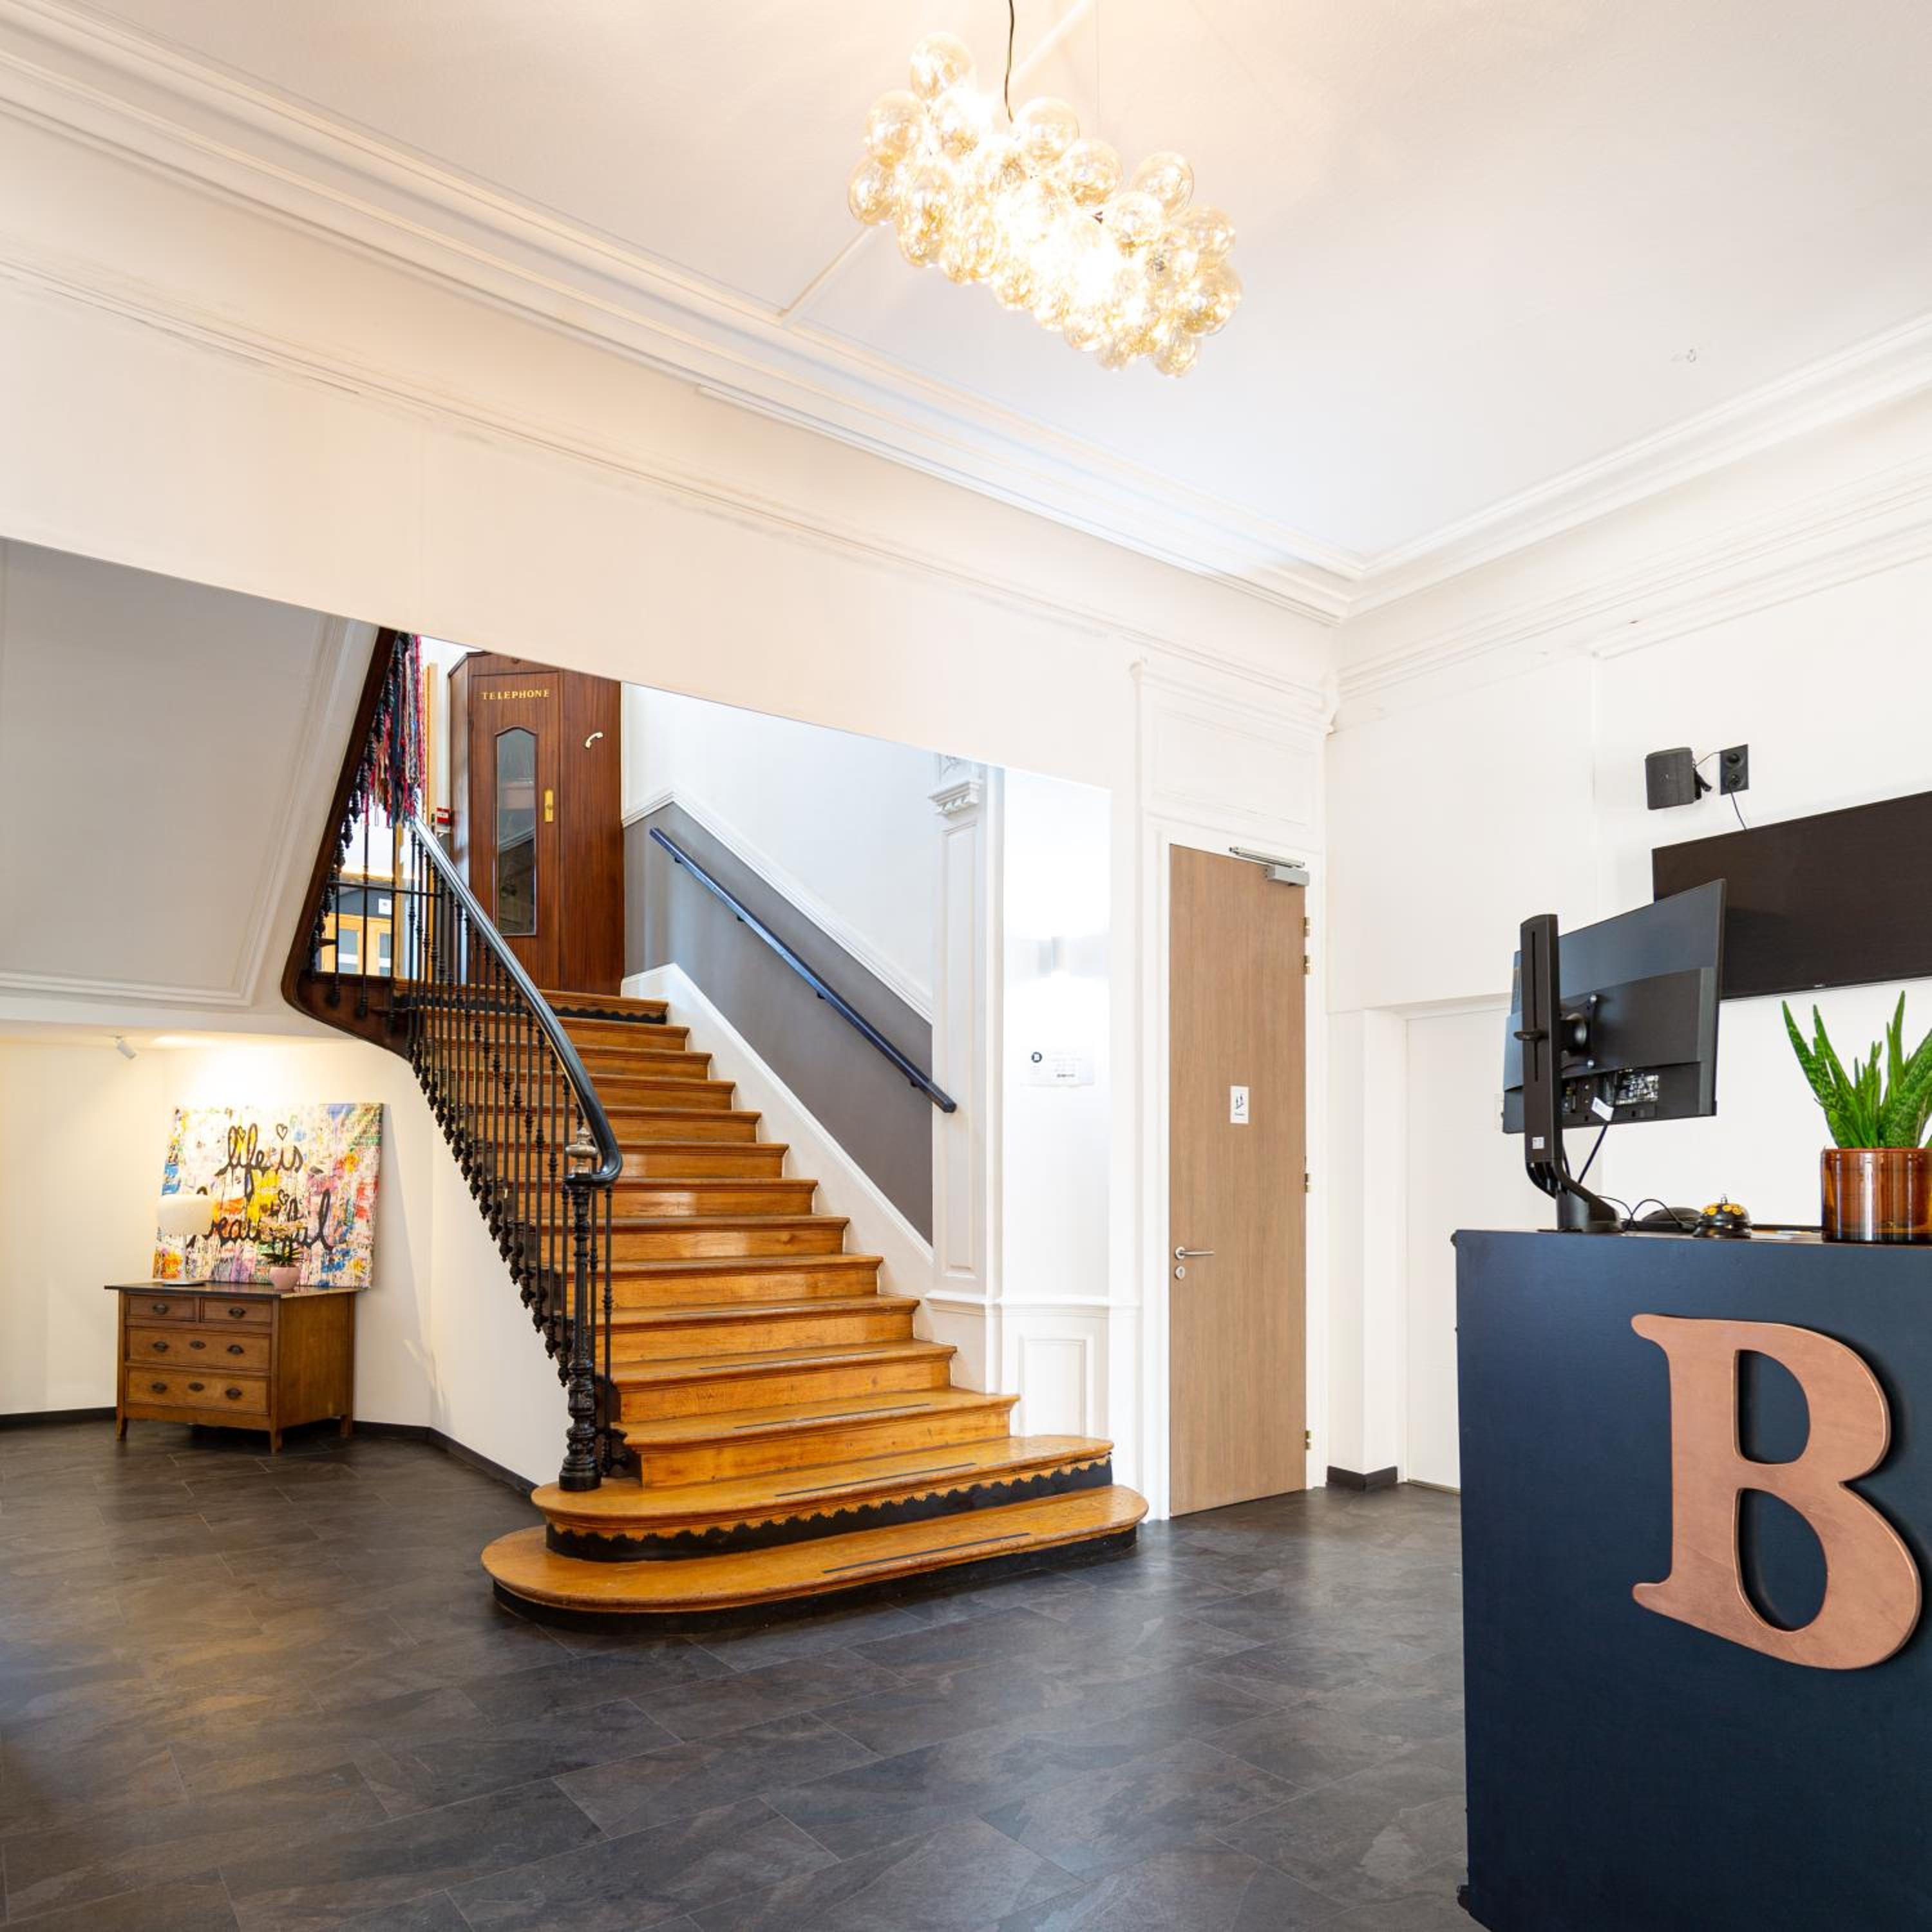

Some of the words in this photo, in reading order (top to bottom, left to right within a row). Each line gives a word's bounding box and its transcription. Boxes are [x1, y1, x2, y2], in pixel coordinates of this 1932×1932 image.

[482, 689, 550, 700] TELEPHONE
[214, 1123, 270, 1202] life
[275, 1123, 304, 1173] is
[1631, 1314, 1922, 1670] B
